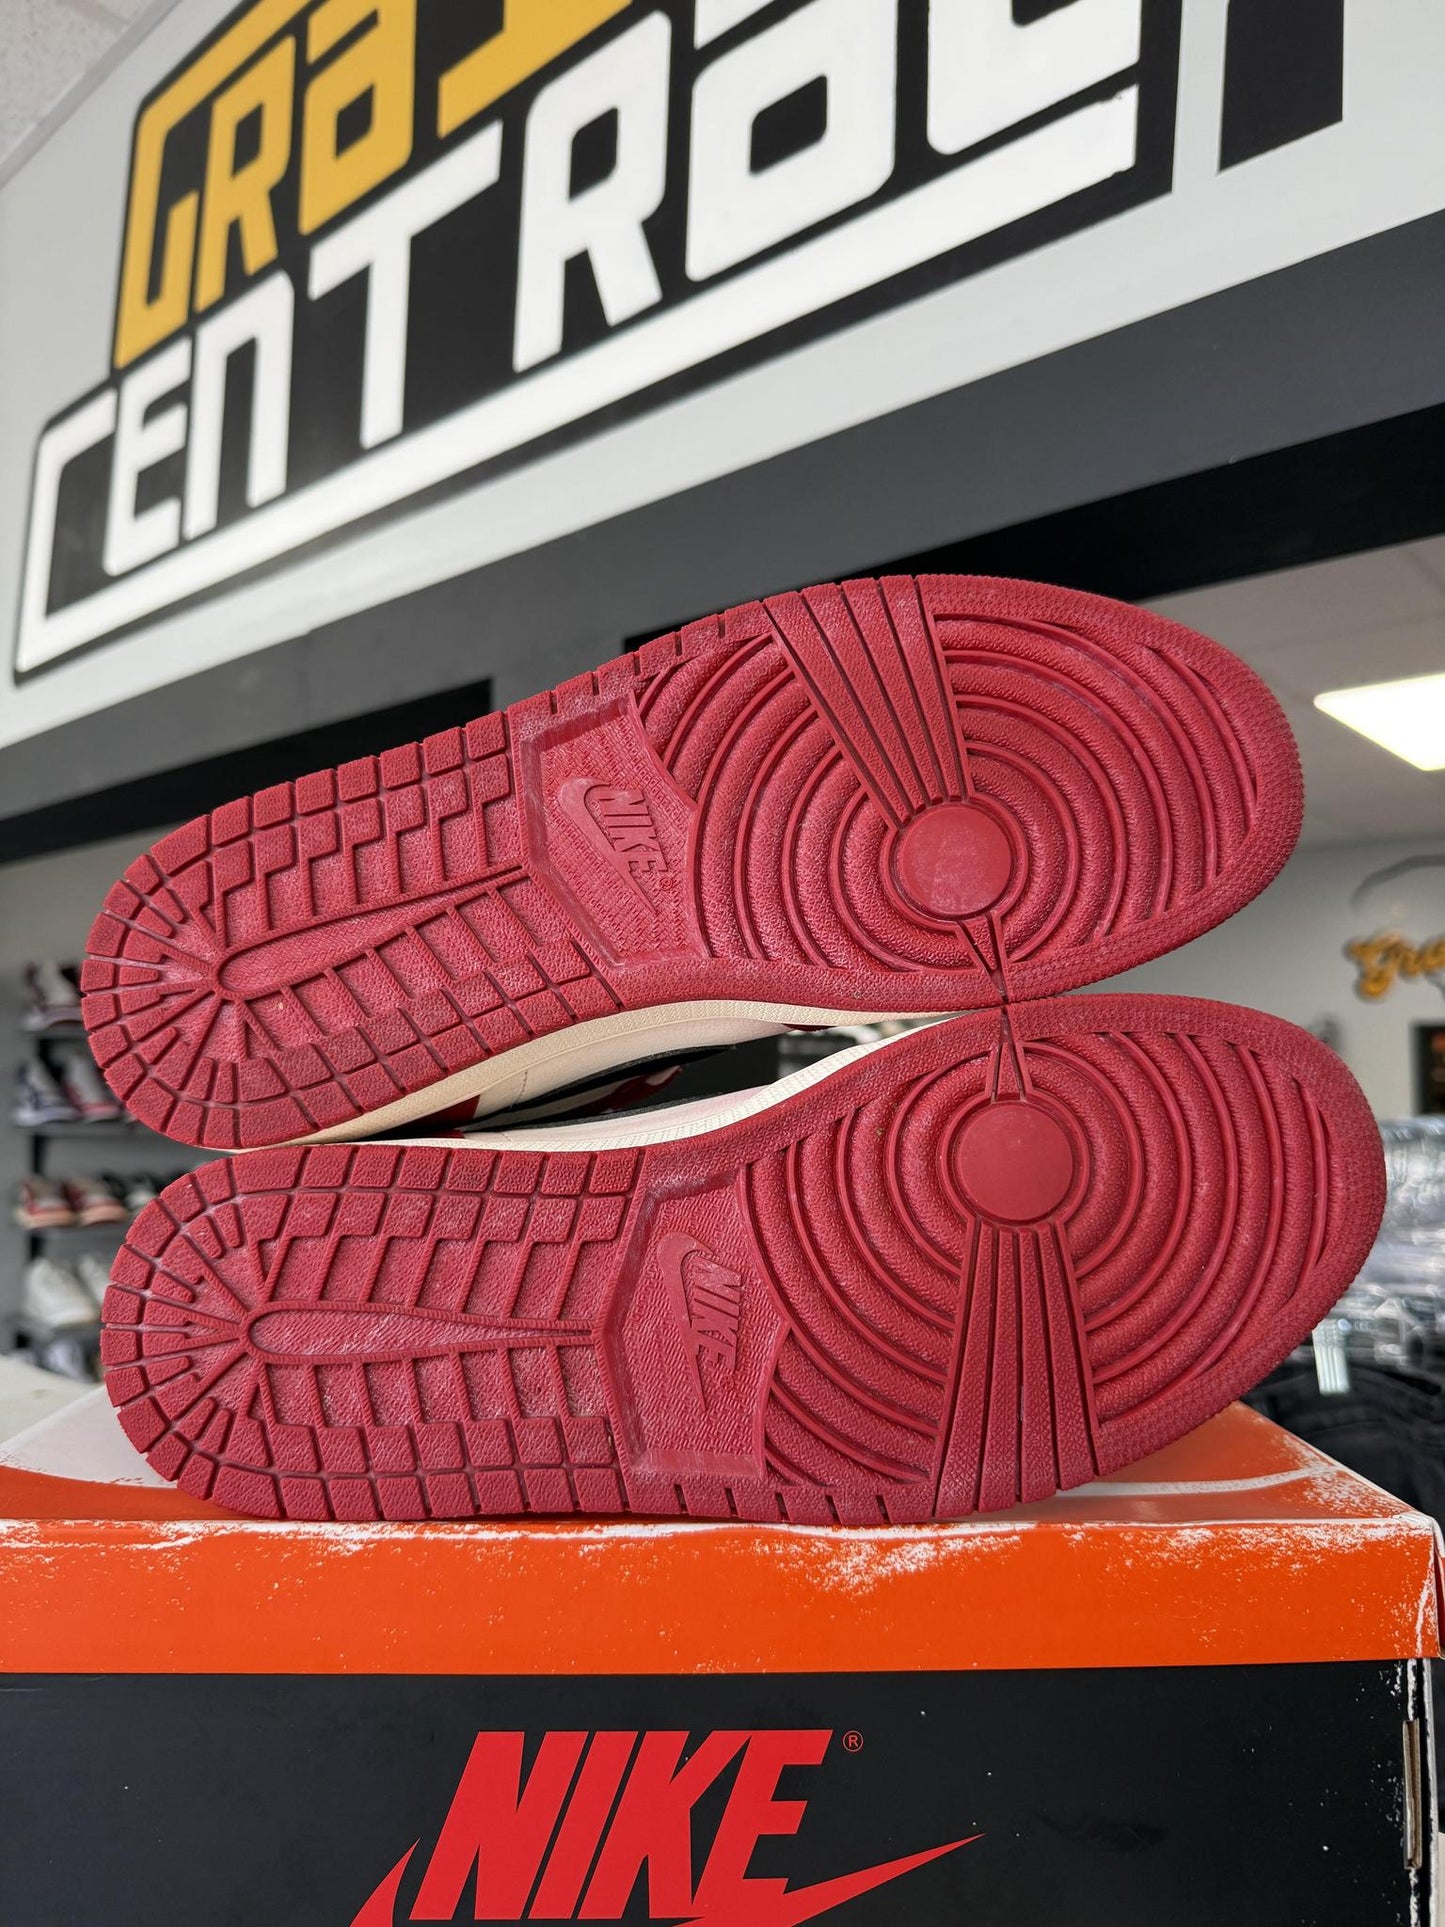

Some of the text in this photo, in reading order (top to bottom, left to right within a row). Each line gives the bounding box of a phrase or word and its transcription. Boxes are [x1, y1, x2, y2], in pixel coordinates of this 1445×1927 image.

[596, 786, 669, 873] NIKE
[691, 1256, 743, 1375] NIKE
[408, 1729, 834, 1920] NIKE
